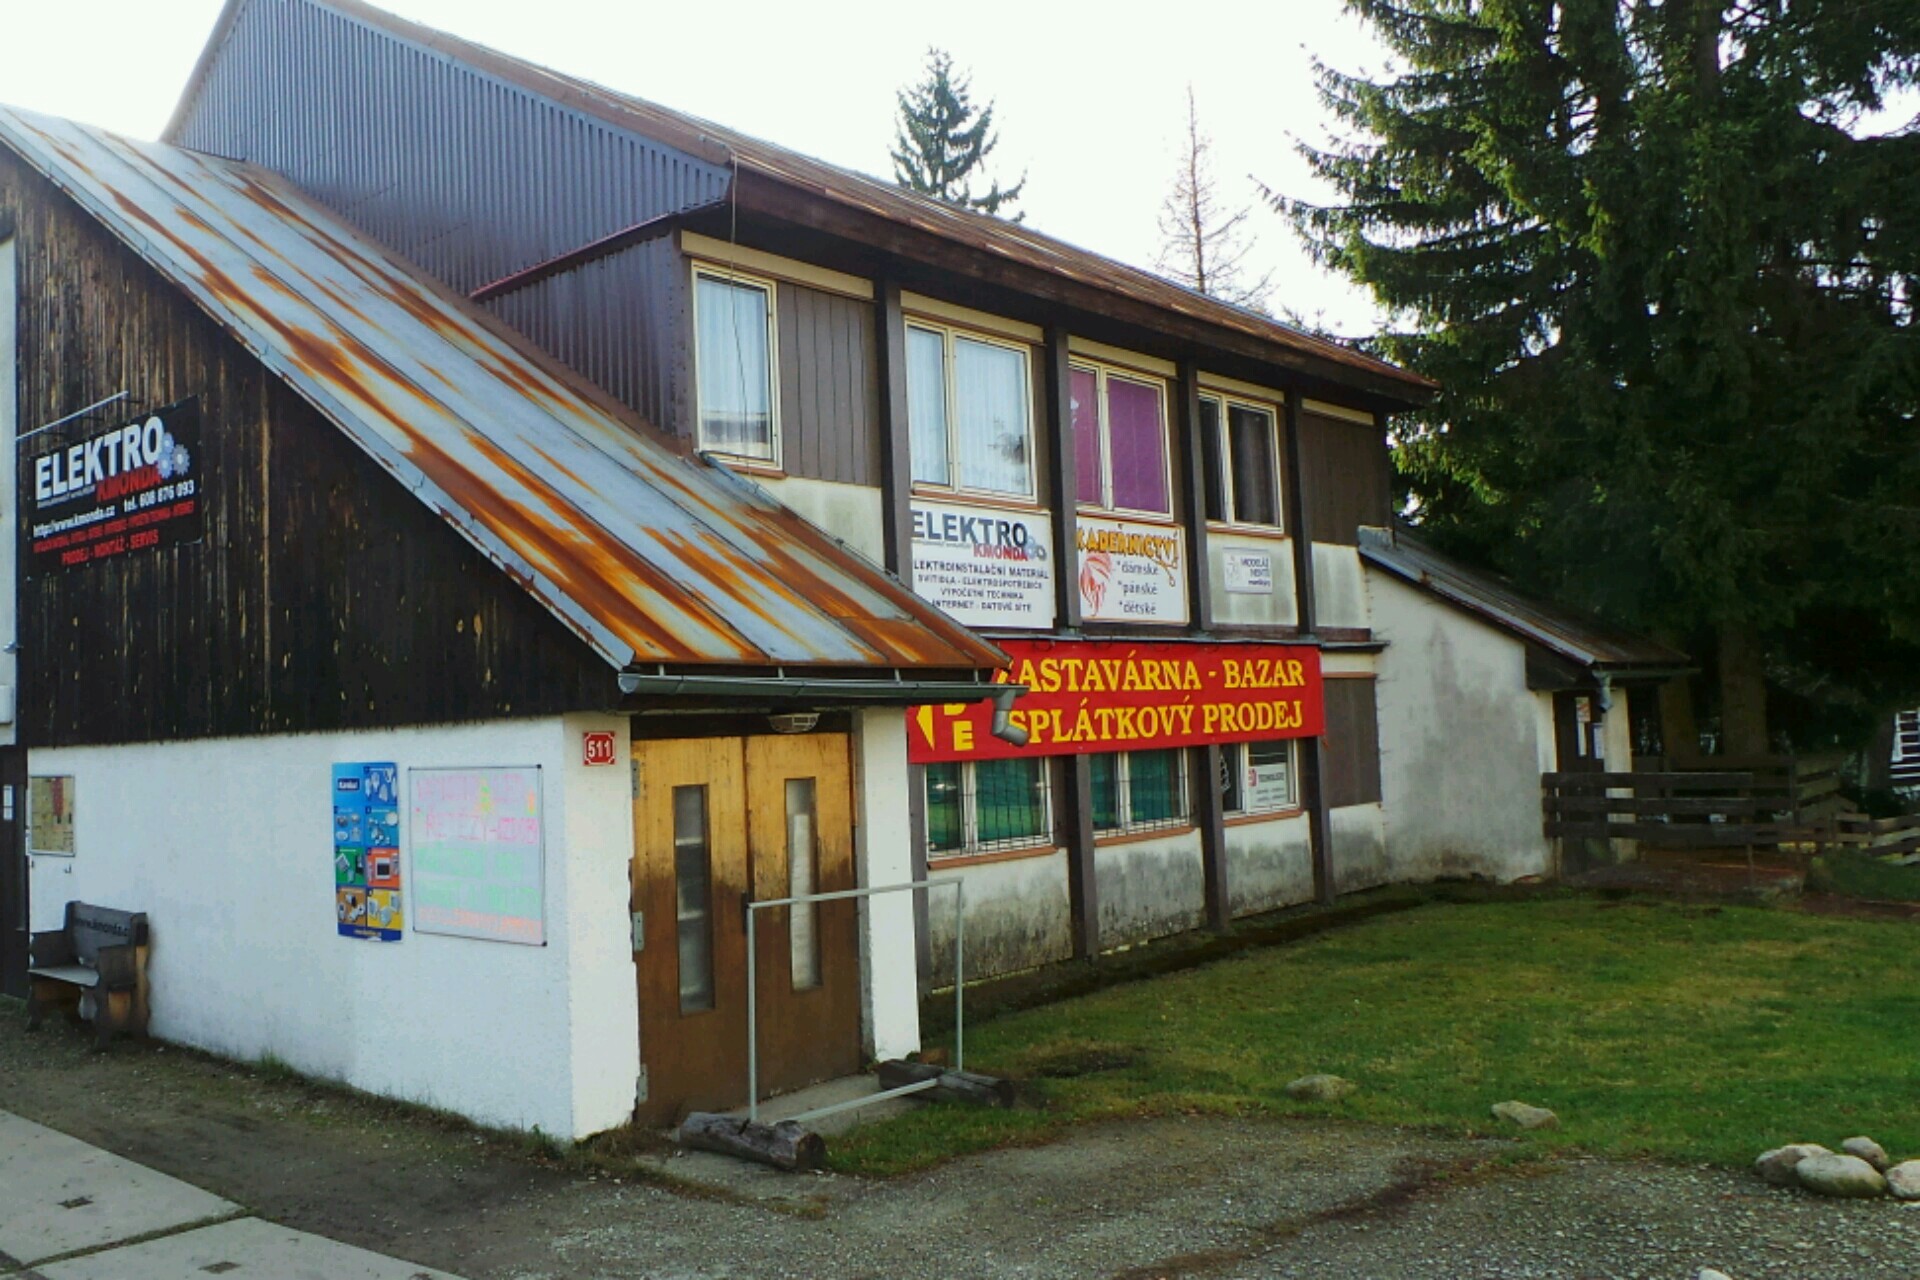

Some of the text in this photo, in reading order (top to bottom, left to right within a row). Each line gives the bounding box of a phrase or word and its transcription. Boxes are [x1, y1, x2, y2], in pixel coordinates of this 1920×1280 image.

[35, 416, 165, 500] ELEKTRO
[911, 510, 1028, 547] ELEKTRO
[1076, 523, 1179, 562] KADEŘNICTVÍ
[914, 560, 1006, 576] LEKTROINSTALAČNÍ
[973, 543, 1028, 561] KMONDA
[1222, 659, 1305, 688] BAZAR
[1008, 694, 1303, 743] SPLÁTKOVÝ PRODEJ
[588, 740, 610, 758] 511
